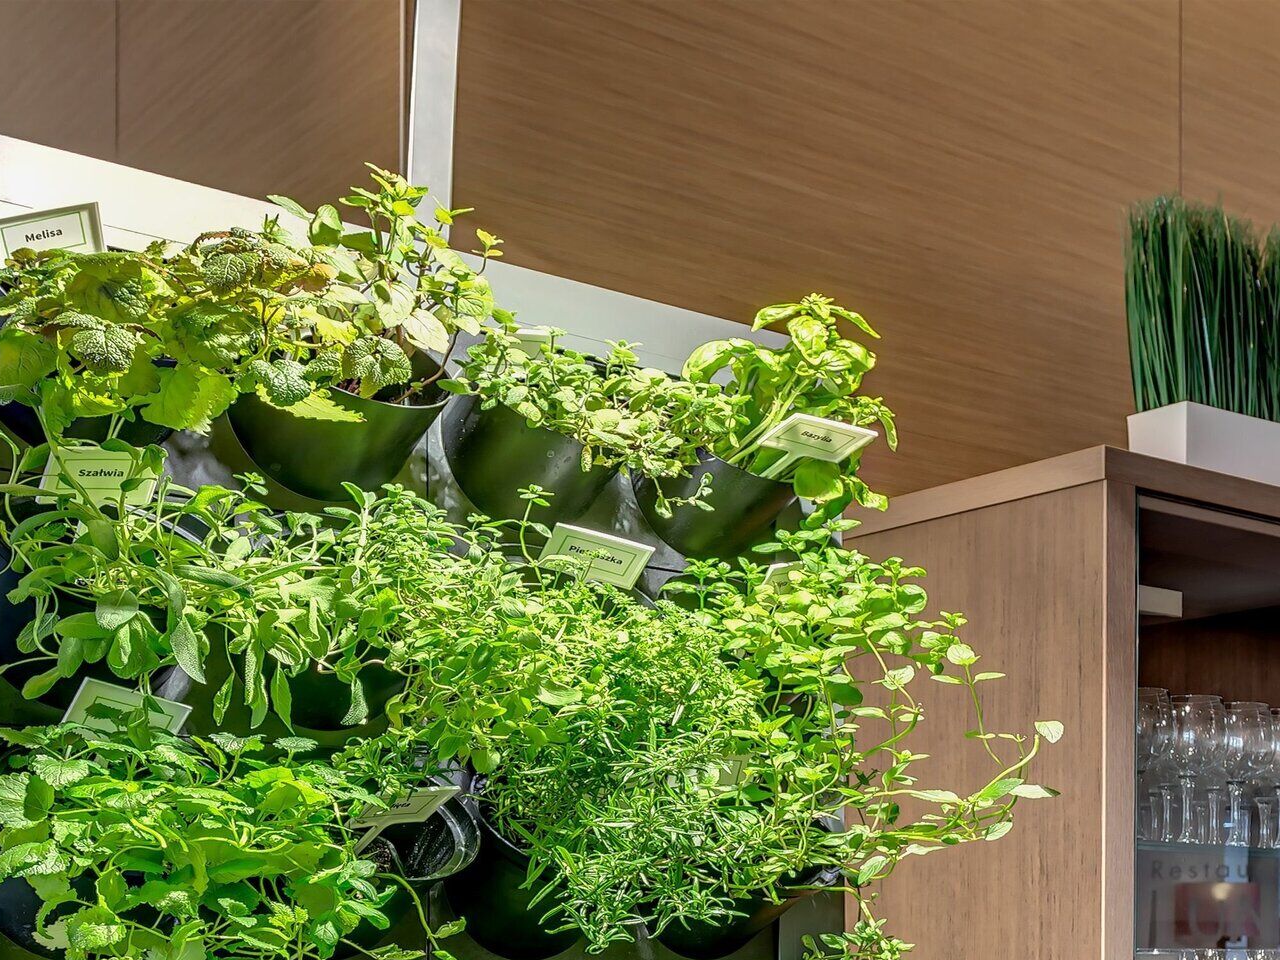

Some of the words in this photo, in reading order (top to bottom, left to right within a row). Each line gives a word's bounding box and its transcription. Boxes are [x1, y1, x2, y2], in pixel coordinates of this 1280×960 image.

[24, 227, 63, 243] Melisa
[800, 430, 833, 443] Bazylia
[78, 468, 124, 477] Szałwia
[568, 545, 624, 565] Pieszka
